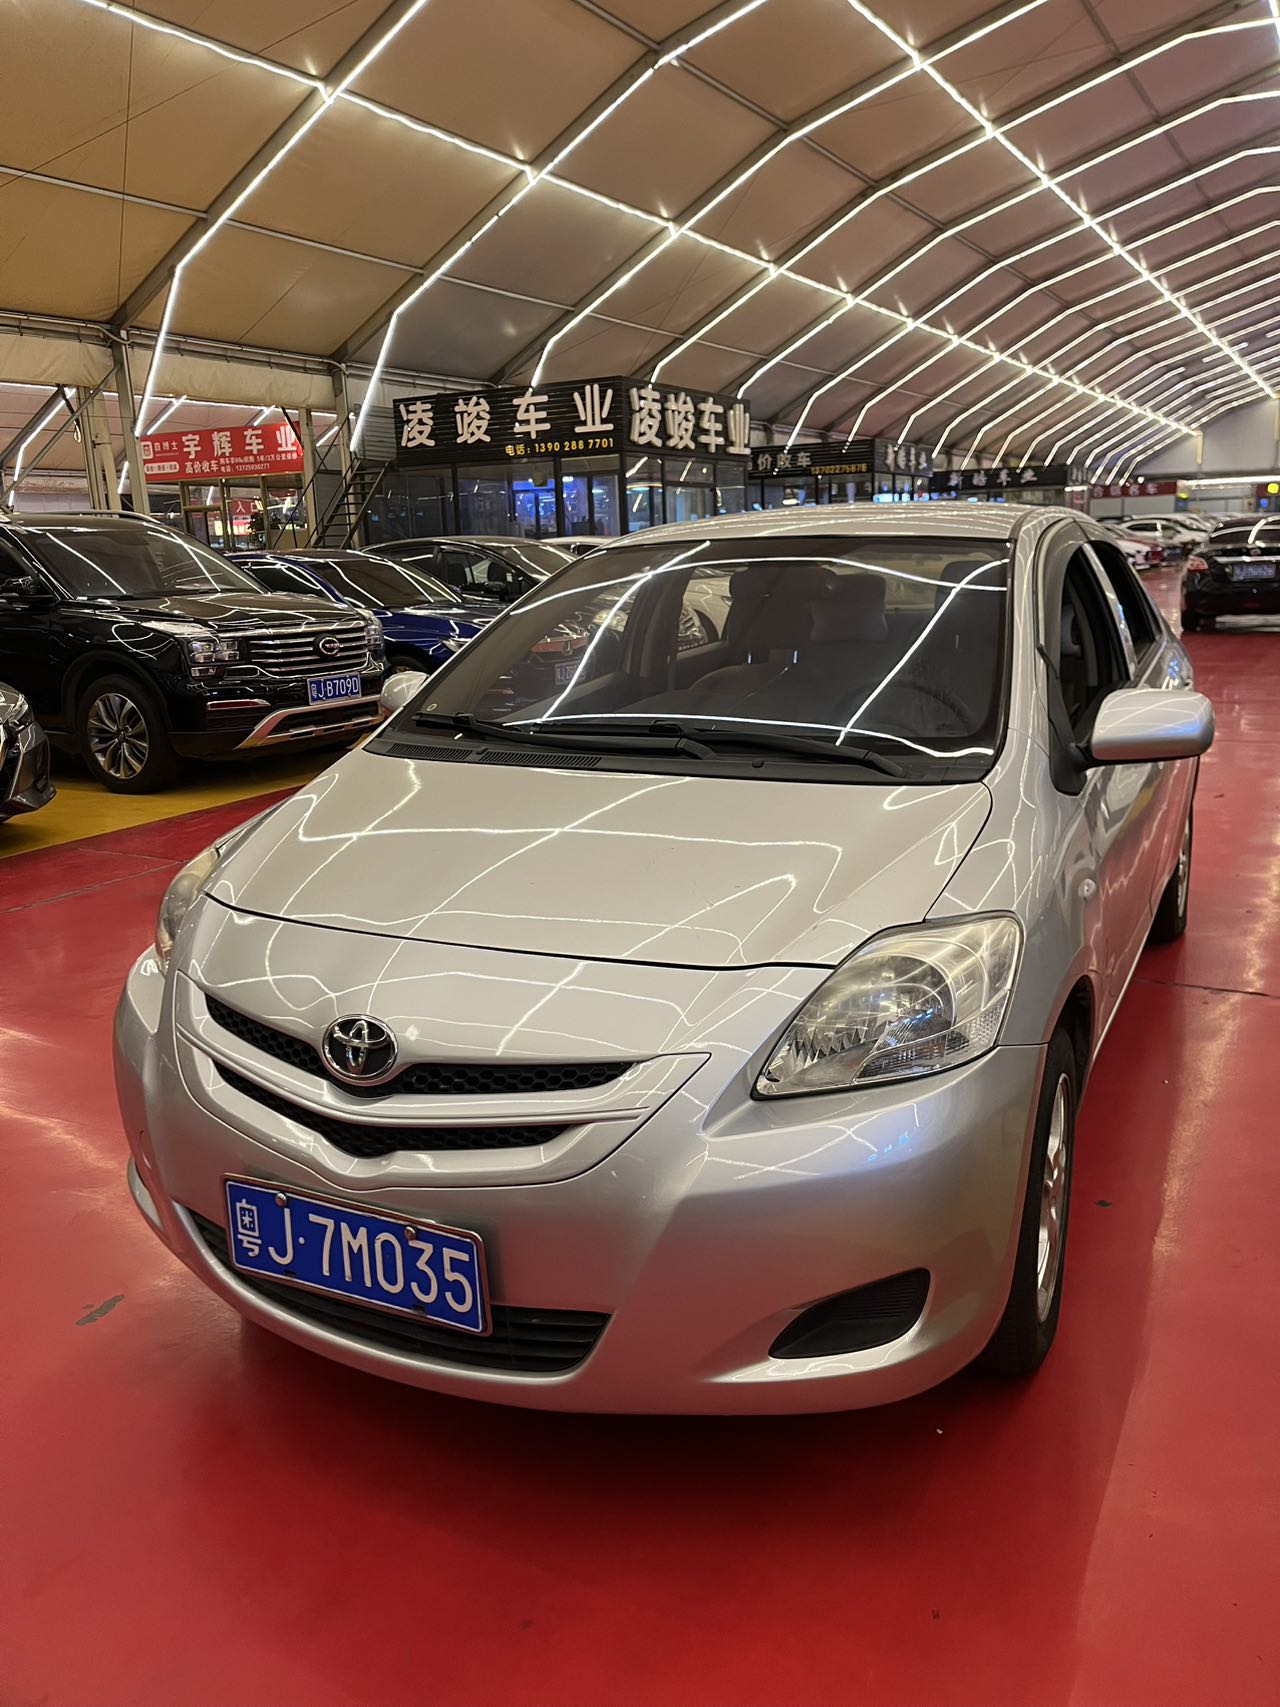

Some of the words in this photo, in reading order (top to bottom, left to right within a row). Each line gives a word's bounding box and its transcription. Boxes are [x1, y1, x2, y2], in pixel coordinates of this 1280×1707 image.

[181, 425, 298, 459] 宇辉车业
[534, 442, 561, 453] 1390
[563, 440, 585, 451] 288
[587, 438, 614, 449] 7701
[184, 459, 219, 475] 高价收车
[235, 1198, 474, 1314] 粤J·7M035
